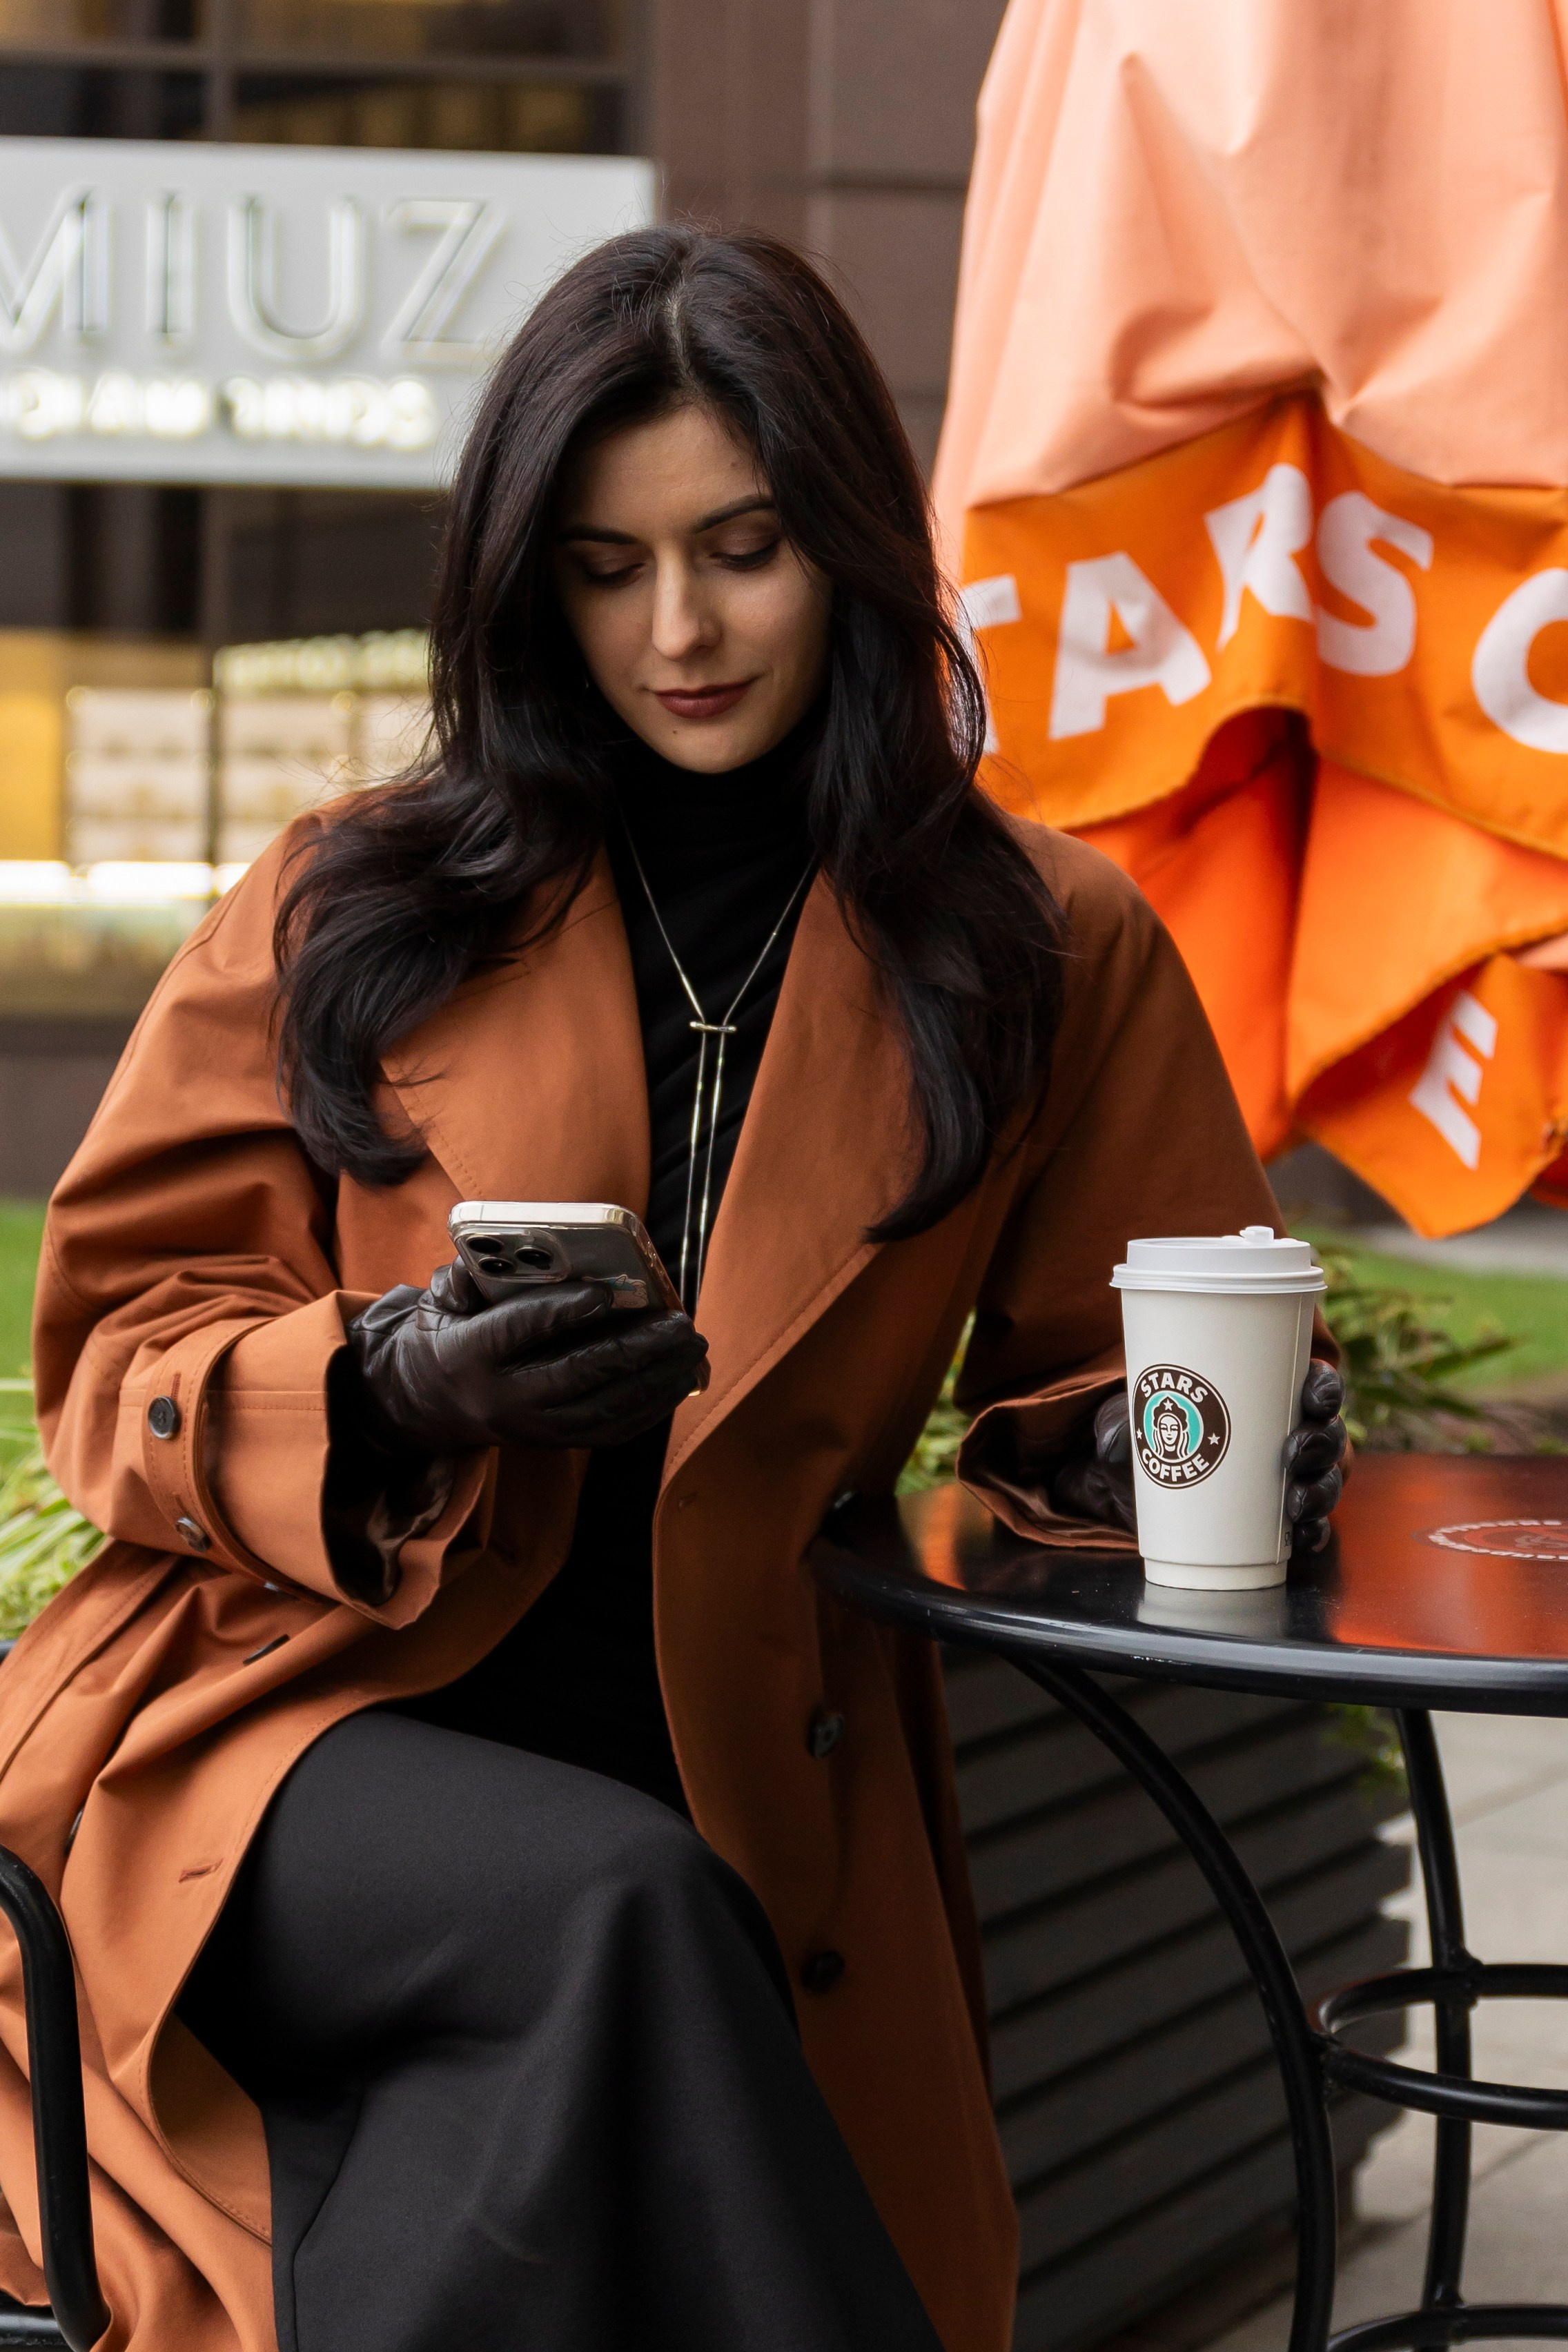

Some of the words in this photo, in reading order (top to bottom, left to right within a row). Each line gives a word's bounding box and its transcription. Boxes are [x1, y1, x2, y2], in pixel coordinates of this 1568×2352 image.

[0, 181, 509, 362] MIUZ
[1140, 1371, 1208, 1403] STARS
[1141, 1448, 1210, 1482] COFFEE
